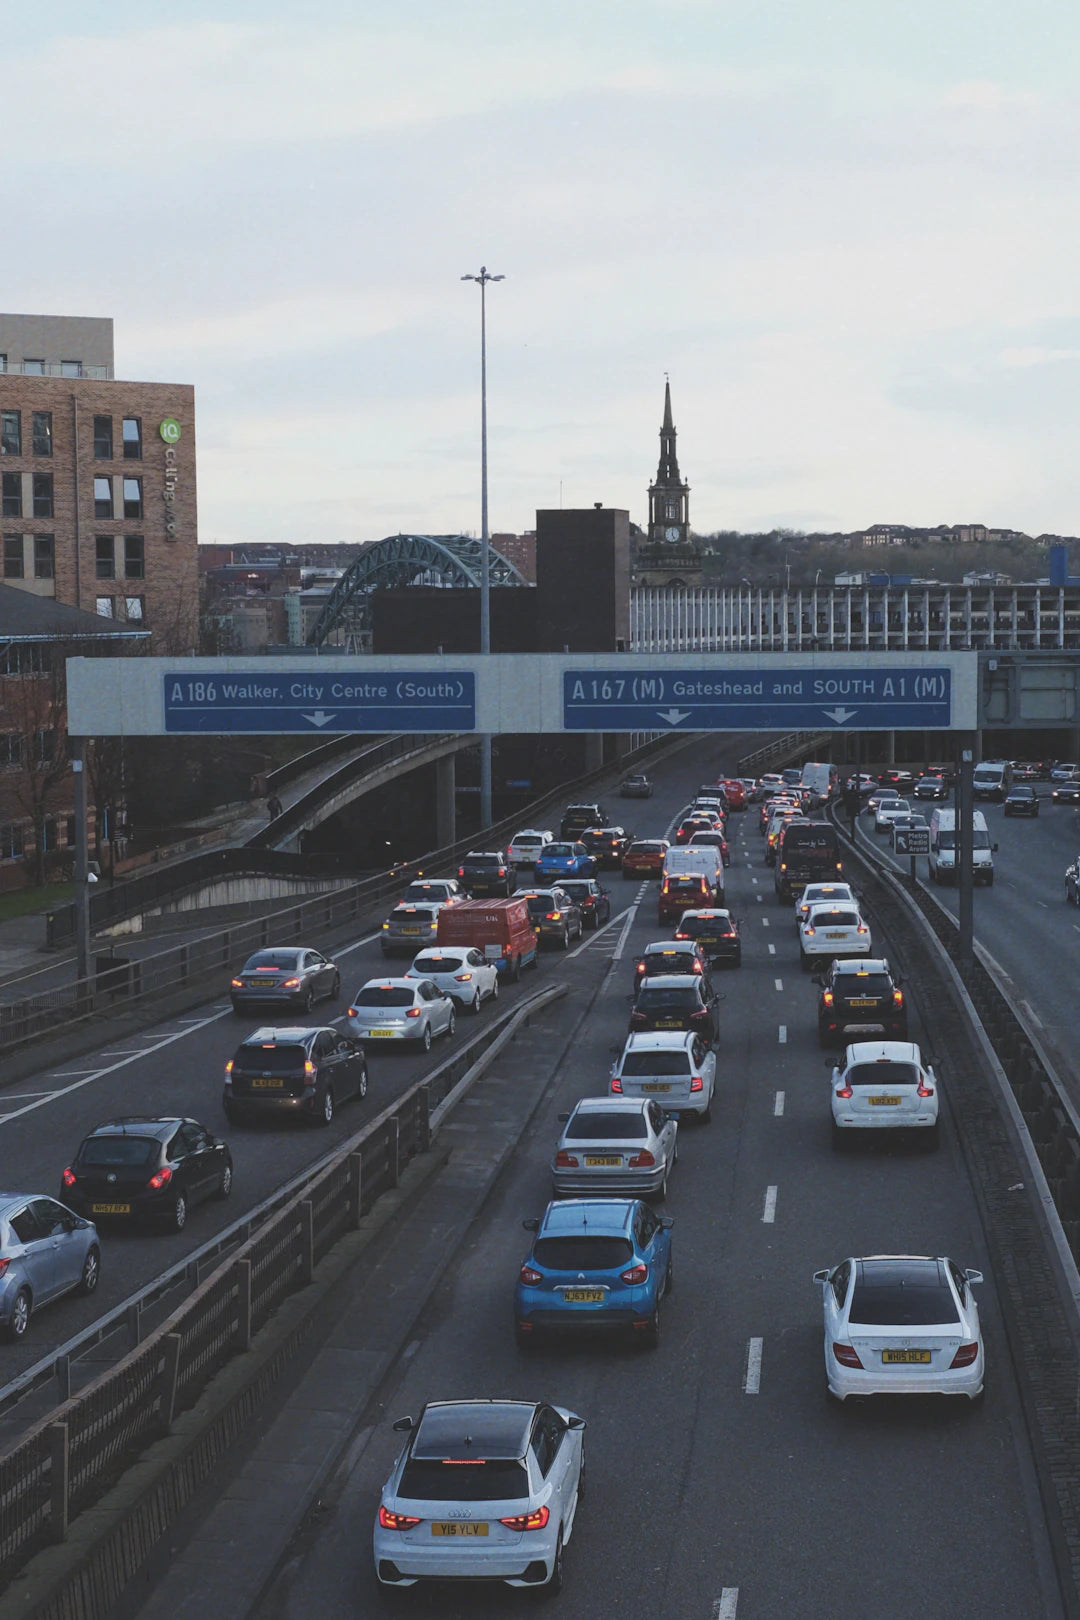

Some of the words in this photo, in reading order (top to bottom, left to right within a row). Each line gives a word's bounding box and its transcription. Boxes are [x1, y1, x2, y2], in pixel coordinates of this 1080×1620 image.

[290, 683, 324, 701] City
[331, 682, 388, 698] Centre
[396, 680, 464, 699] (South)
[672, 681, 763, 696] Gateshead
[772, 680, 803, 695] and
[813, 679, 875, 695] SOUTH
[441, 1524, 457, 1535] Y15
[460, 1524, 479, 1535] YLV
